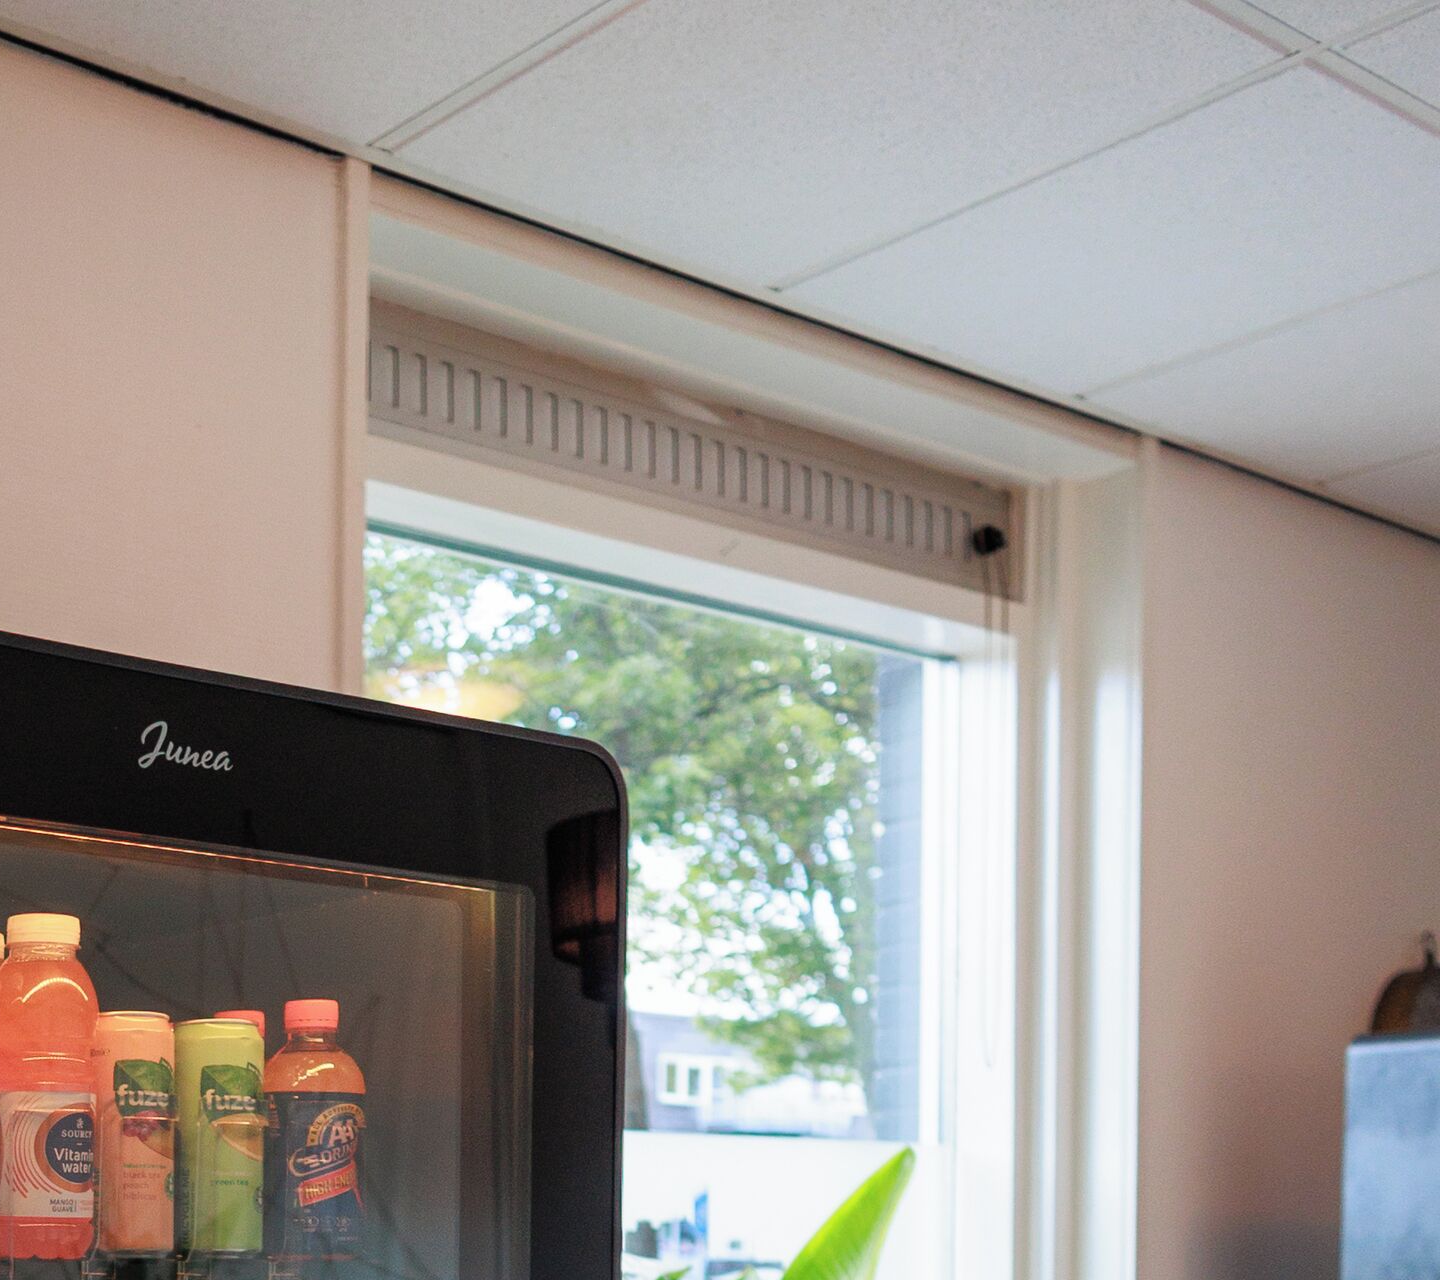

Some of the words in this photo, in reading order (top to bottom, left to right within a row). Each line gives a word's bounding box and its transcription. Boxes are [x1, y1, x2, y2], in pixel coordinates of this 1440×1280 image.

[138, 720, 234, 771] Junea
[116, 1083, 170, 1107] fuze
[204, 1088, 257, 1112] fuze
[61, 1163, 92, 1174] water
[304, 1179, 332, 1200] HIGH
[49, 1198, 74, 1206] MANGO
